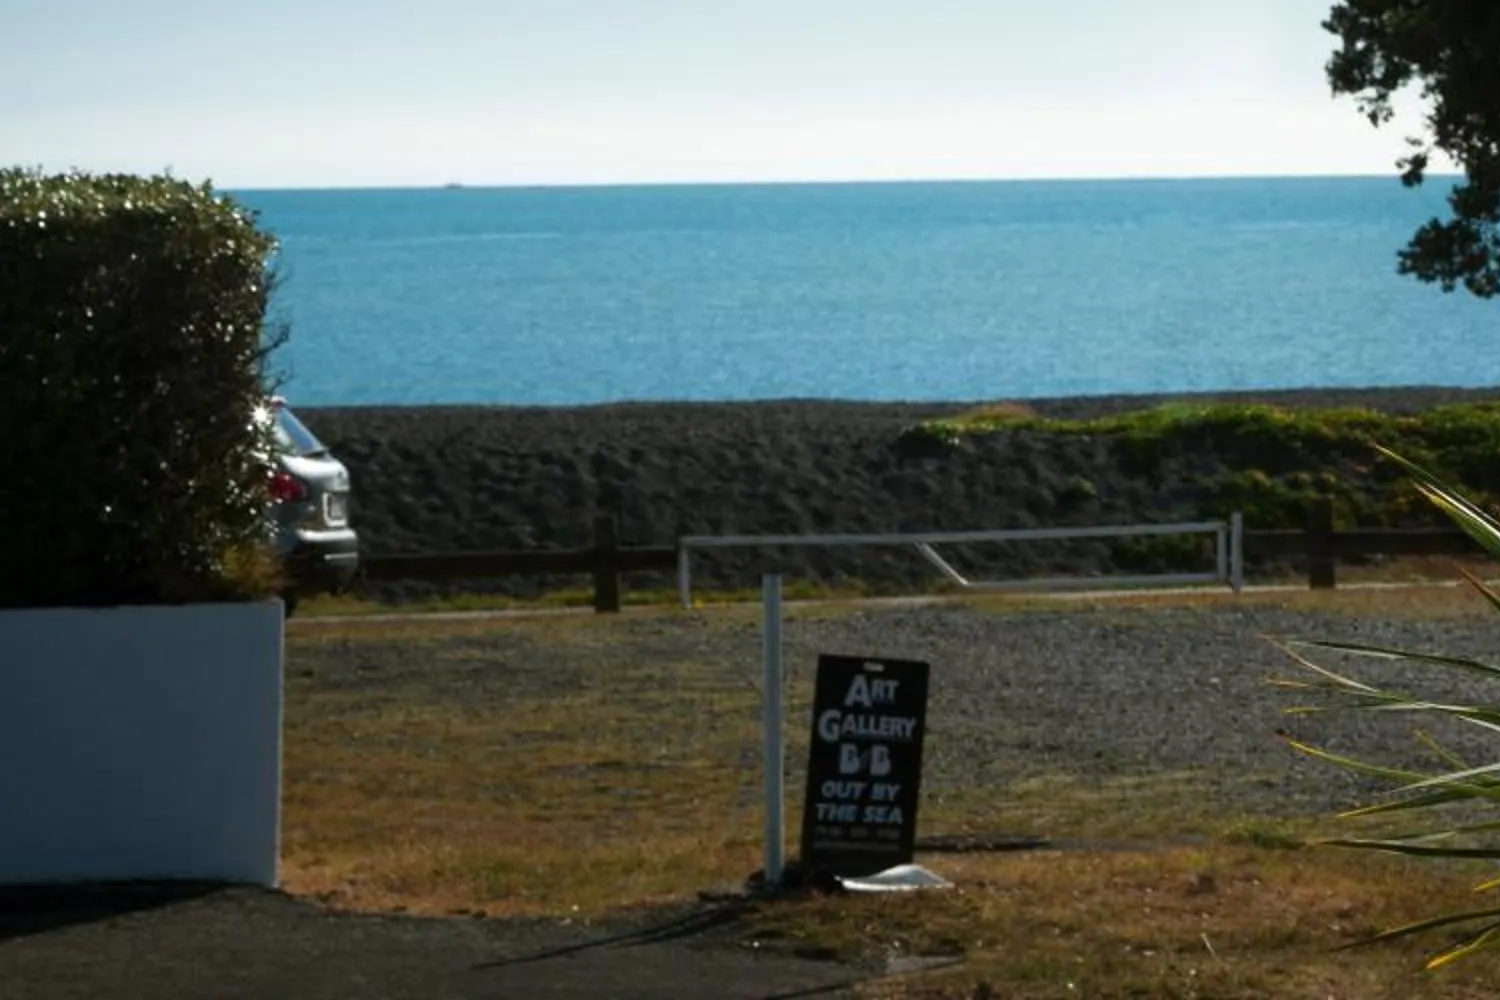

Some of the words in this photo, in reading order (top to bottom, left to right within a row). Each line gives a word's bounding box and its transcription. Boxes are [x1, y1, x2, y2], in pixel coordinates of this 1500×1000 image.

[820, 780, 866, 800] OUT
[870, 783, 902, 801] BY
[815, 803, 858, 823] THE
[862, 806, 903, 825] SEA
